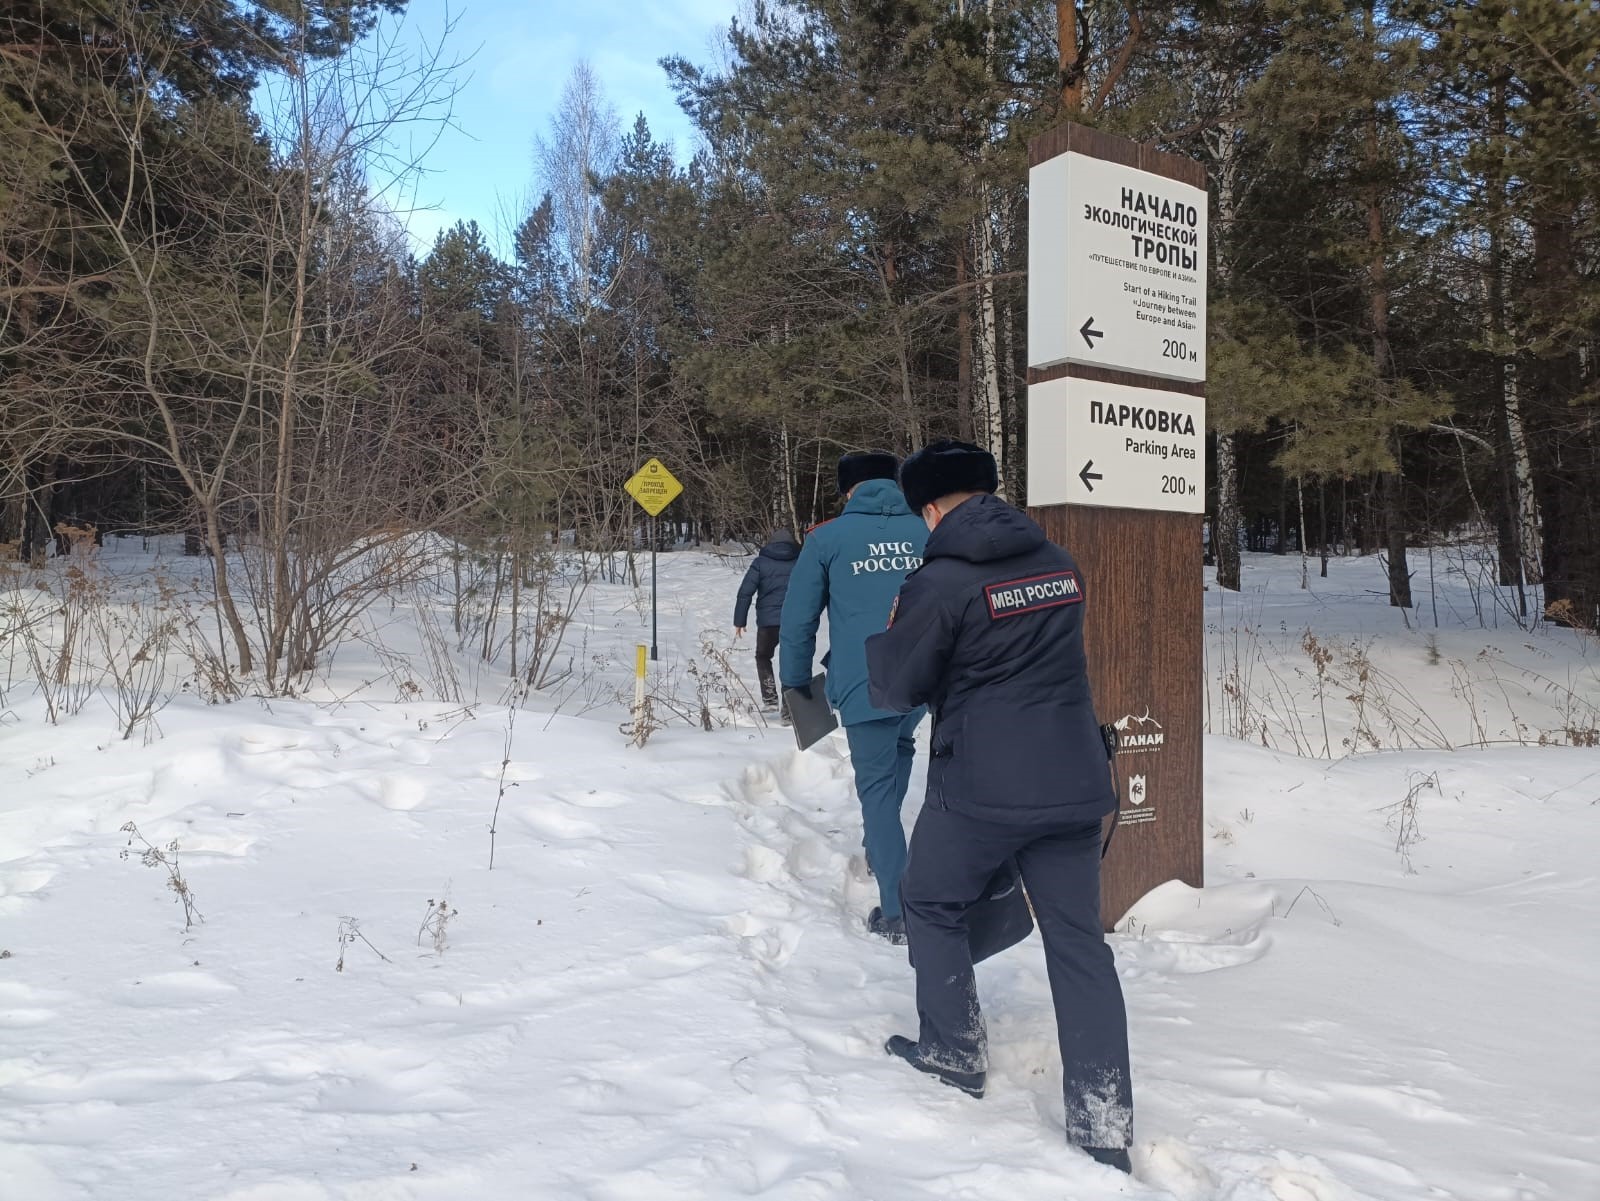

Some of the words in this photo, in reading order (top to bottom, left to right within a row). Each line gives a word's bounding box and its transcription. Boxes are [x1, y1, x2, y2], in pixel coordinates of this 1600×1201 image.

[1121, 187, 1197, 227] НАЧАЛО
[1084, 204, 1197, 247] ЭКОЛОГИЧЕСКОЙ
[1131, 234, 1197, 271] ТРОПЫ
[1089, 253, 1138, 271] «ПУТЕШЕСТВИЕ
[1139, 264, 1148, 273] ПО
[1148, 266, 1171, 278] ЕВРОПЕ
[1123, 282, 1141, 294] Start
[1143, 287, 1150, 296] of
[1157, 290, 1180, 304] Hiking
[1181, 294, 1197, 306] Trail
[1133, 298, 1166, 314] «Journey
[1167, 304, 1197, 318] between
[1136, 310, 1162, 324] Europe
[1162, 318, 1176, 327] and
[1177, 319, 1197, 330] Asia»
[1162, 338, 1187, 360] 200
[1090, 400, 1196, 436] ПАРКОВКА
[1125, 437, 1168, 460] Parking
[1171, 443, 1196, 459] Area
[1161, 474, 1186, 494] 200
[867, 541, 914, 556] МЧС
[990, 588, 1027, 610] МВД
[1025, 578, 1079, 602] РОССИИ
